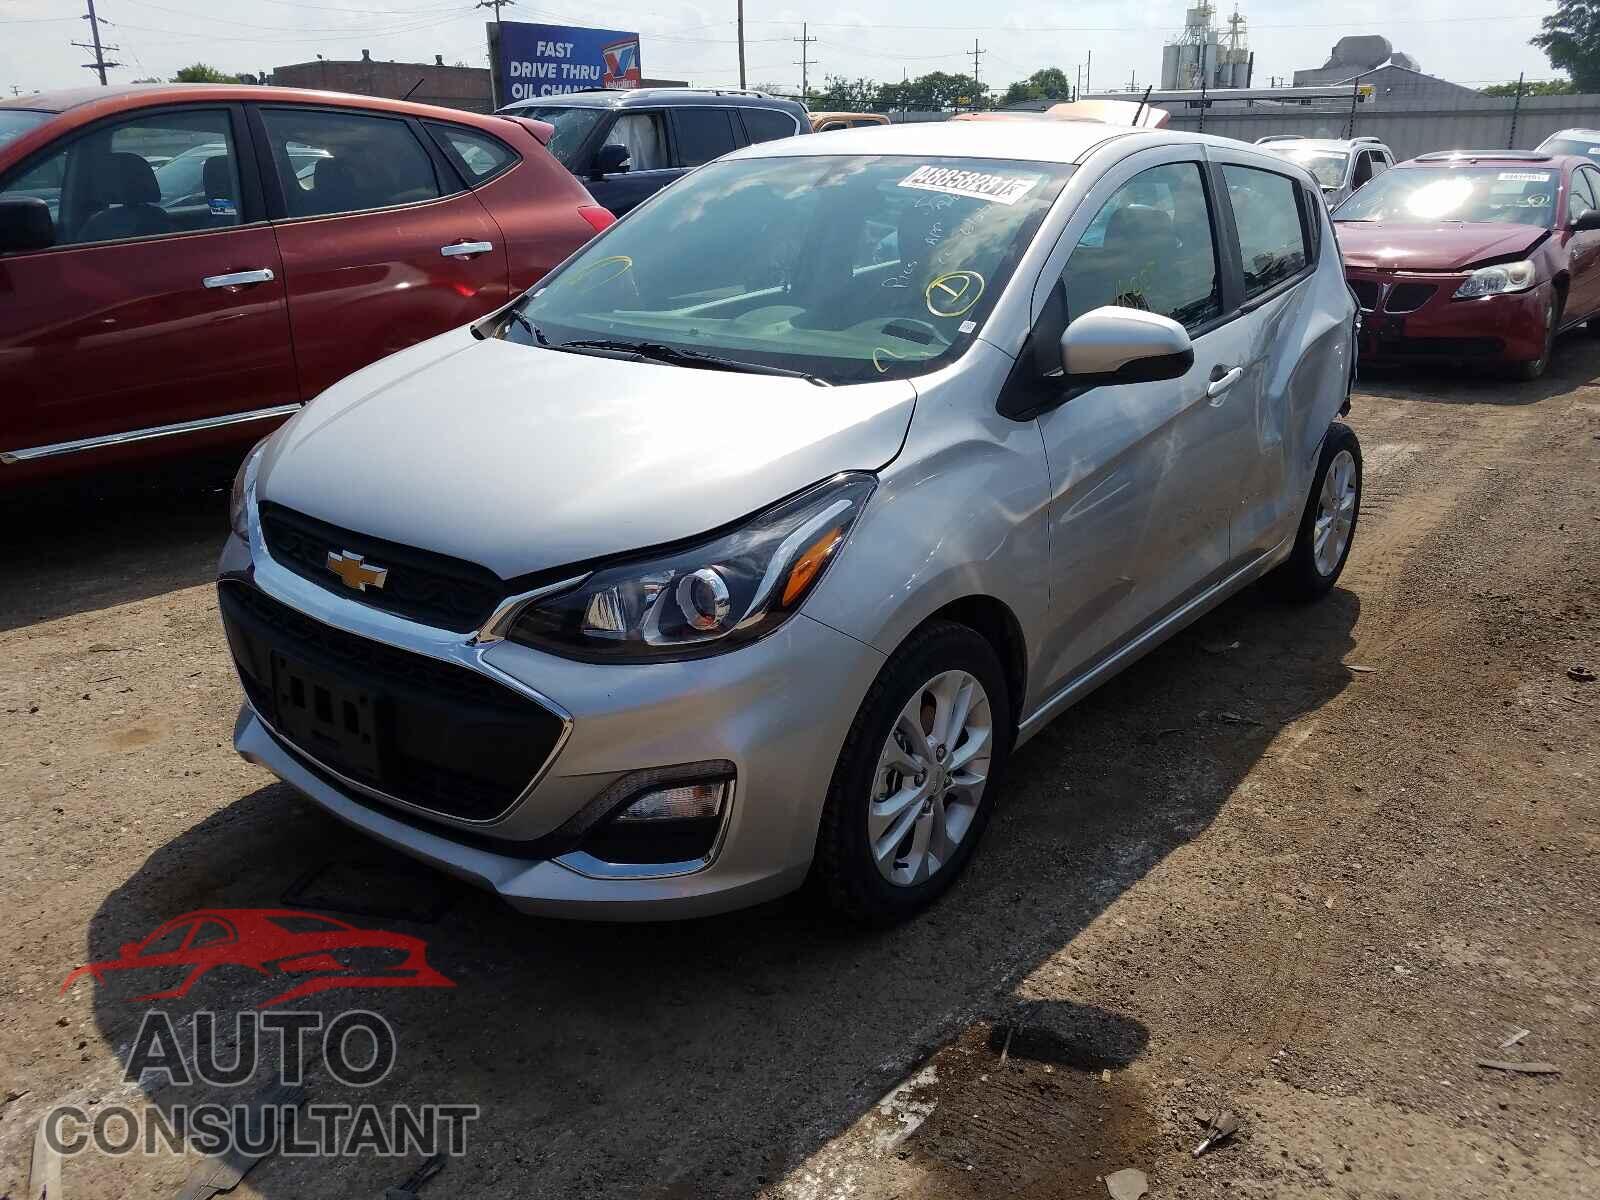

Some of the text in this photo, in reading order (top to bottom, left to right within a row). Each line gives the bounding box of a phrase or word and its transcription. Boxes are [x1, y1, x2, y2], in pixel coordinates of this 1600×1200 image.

[536, 40, 574, 58] FAST
[510, 61, 601, 80] DRIVE THRU
[511, 82, 601, 99] OIL CHAN
